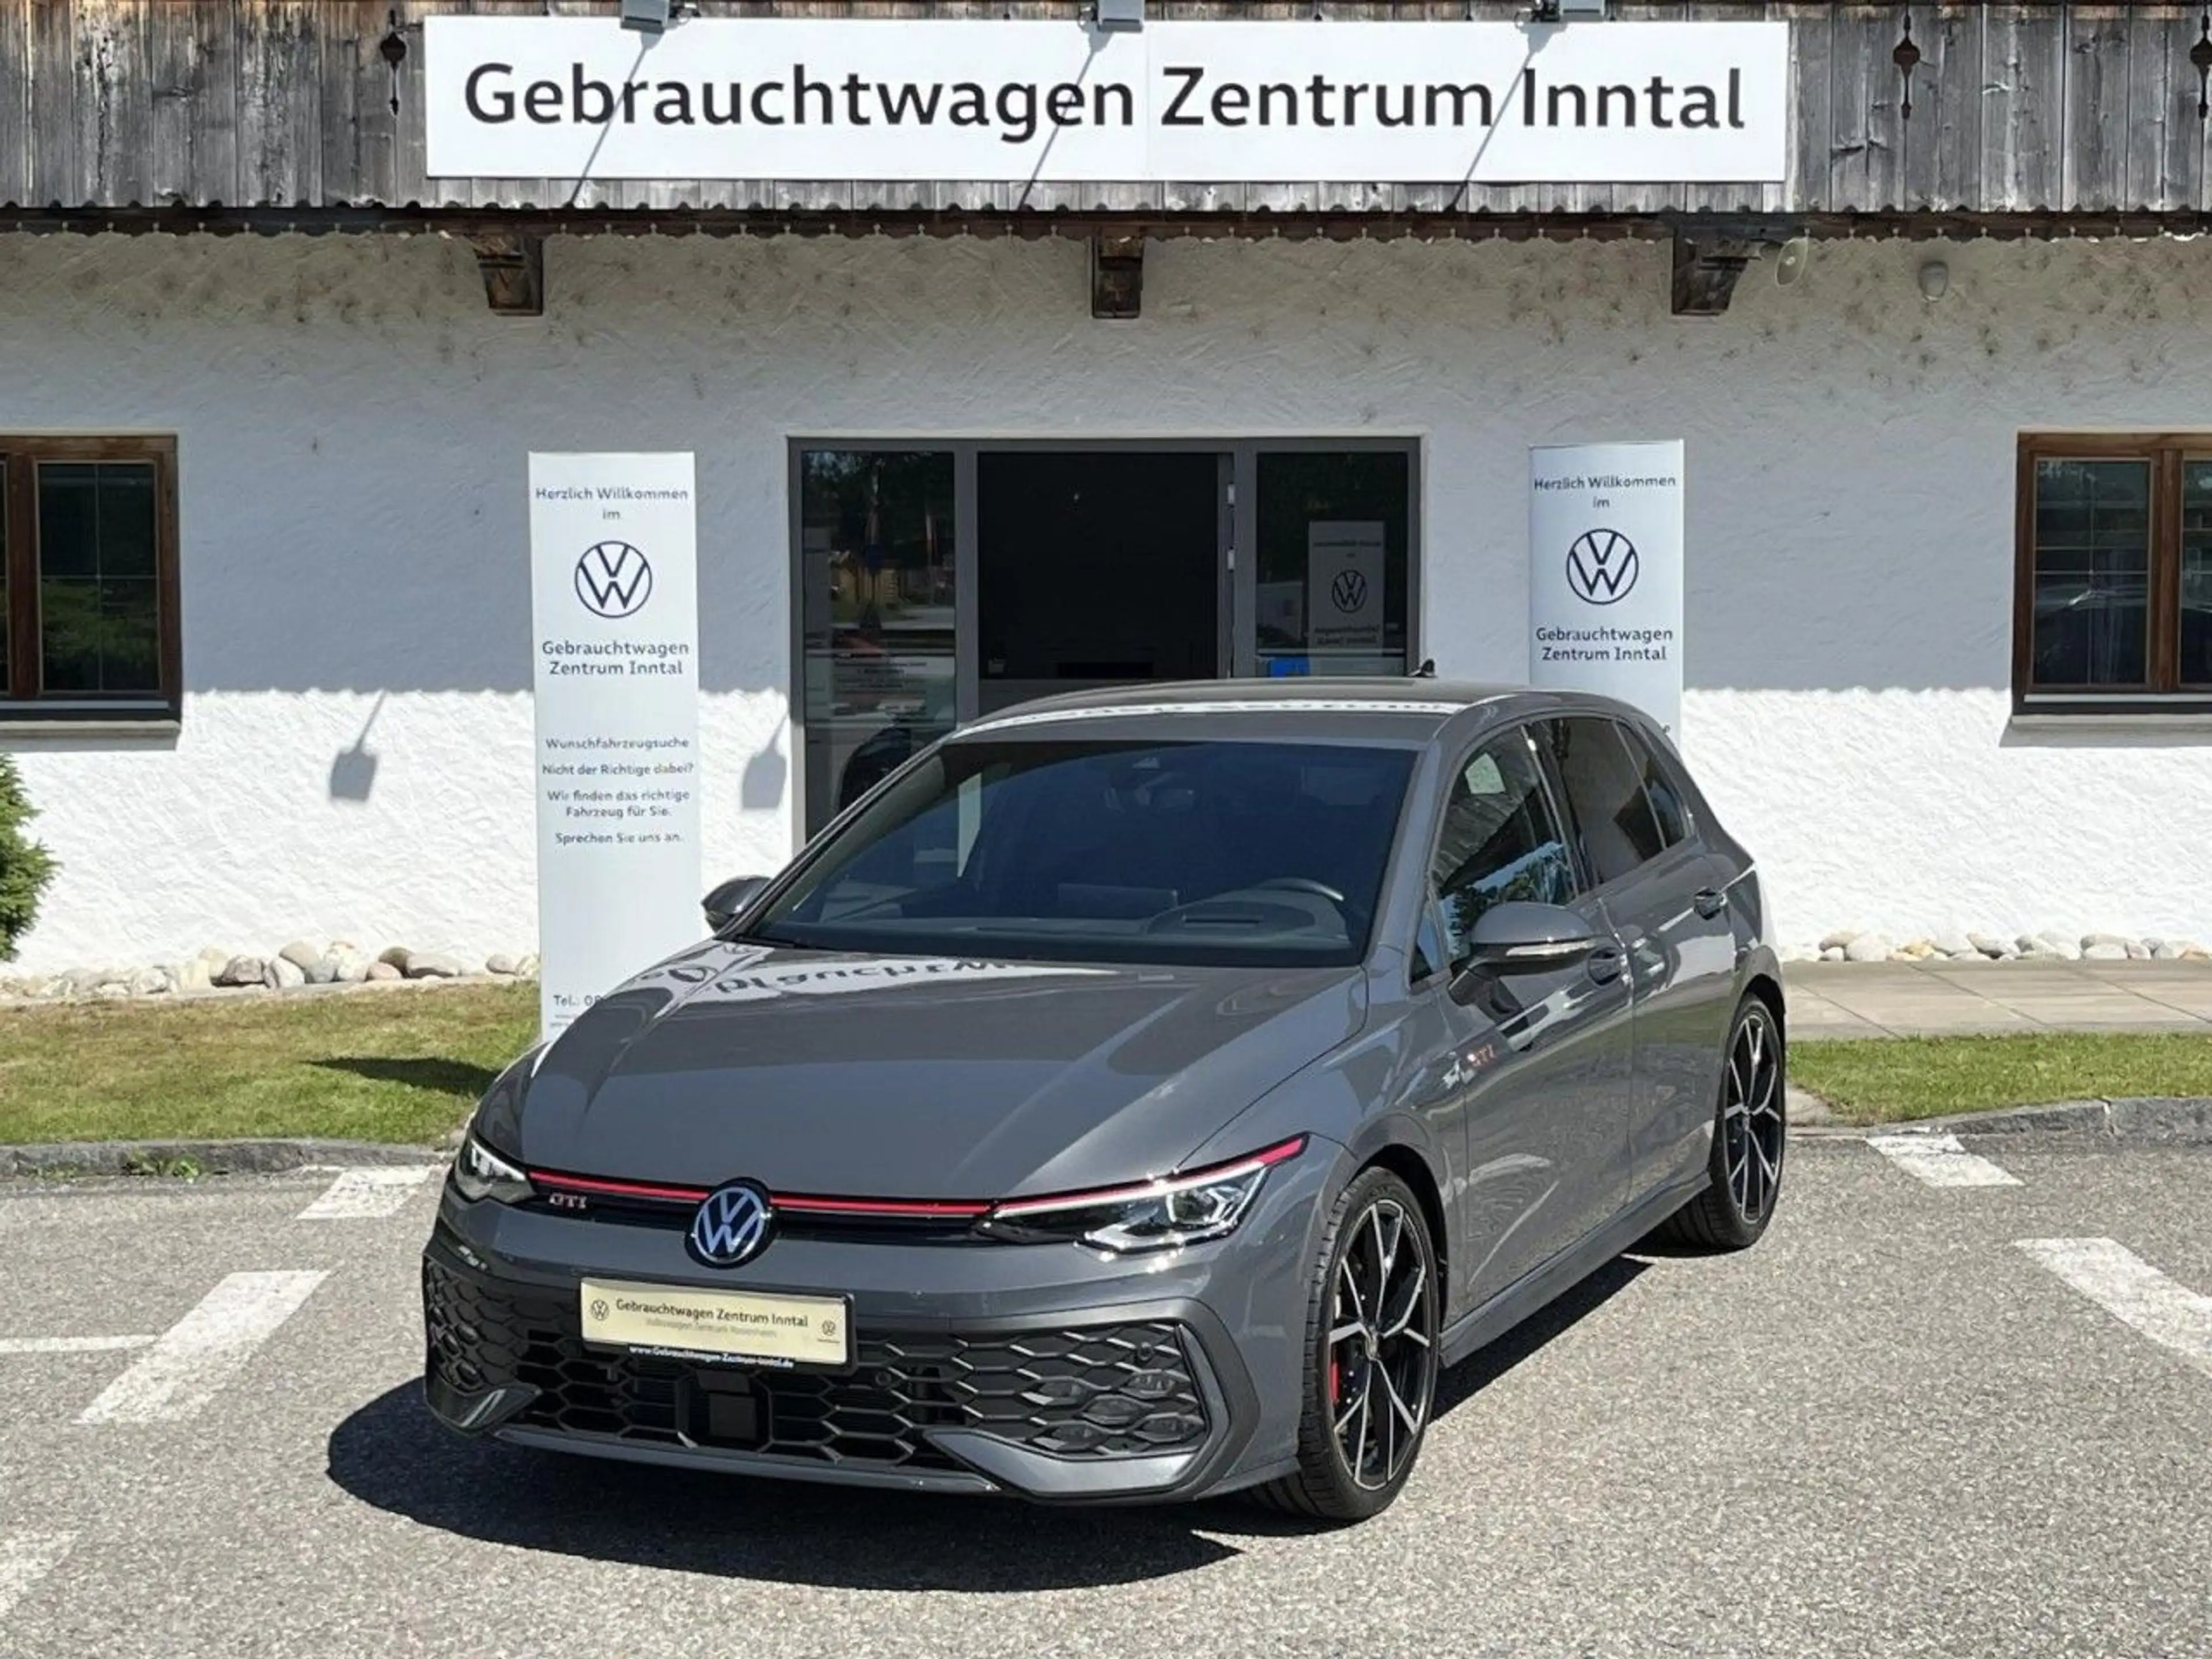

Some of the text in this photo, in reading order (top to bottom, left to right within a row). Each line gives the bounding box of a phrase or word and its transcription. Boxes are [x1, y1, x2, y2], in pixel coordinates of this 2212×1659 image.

[464, 62, 1745, 143] Gebrauchtwagen Zentrum Inntal
[1533, 475, 1676, 490] Herzlich Willkommen
[535, 487, 688, 499] Herzlich Willkommen
[1593, 497, 1610, 508] im
[603, 509, 620, 520] im
[1536, 627, 1673, 645] Gebrauchtwagen
[542, 640, 689, 659] Gebrauchtwagen
[1541, 646, 1666, 662] Zentrum Inntal
[549, 660, 683, 676] Zentrum Inntal
[546, 736, 690, 750] Wunschfahrzeugsuche
[542, 763, 694, 777] Nicht der Richtige dabei?
[547, 790, 690, 802] Wir finden das richtige
[566, 806, 624, 819] Fahrzeug
[627, 805, 645, 816] für
[555, 832, 613, 846] Sprechen
[616, 832, 635, 843] Sie
[638, 834, 661, 843] uns
[549, 1192, 588, 1210] GTI
[615, 1298, 714, 1323] Gebrauchtwagen
[716, 1308, 769, 1325] Zentrum
[772, 1313, 809, 1328] Inntal
